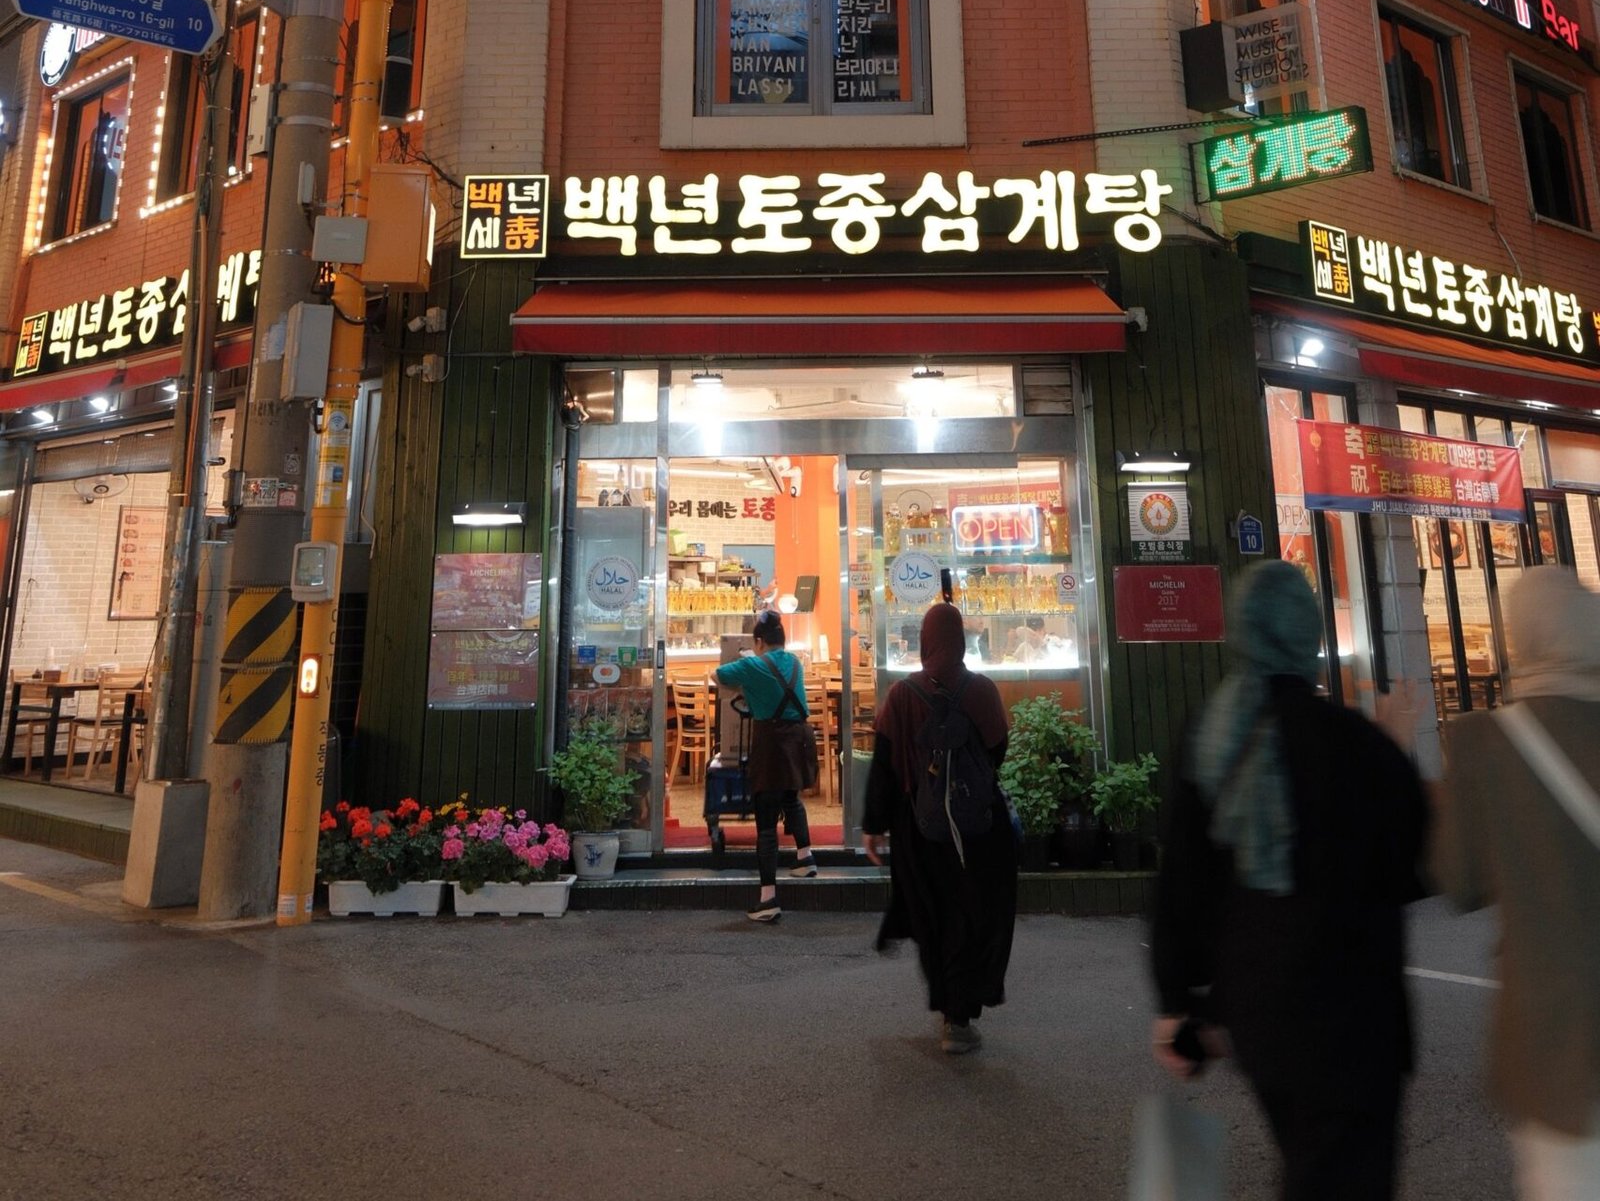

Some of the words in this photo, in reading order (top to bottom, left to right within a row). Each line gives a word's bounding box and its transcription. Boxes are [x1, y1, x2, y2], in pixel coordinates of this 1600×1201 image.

[140, 12, 175, 30] 16-gil
[187, 16, 203, 32] 10
[838, 15, 873, 34] 치킨
[1237, 18, 1281, 40] WISE
[840, 35, 858, 54] 난
[1237, 36, 1288, 62] MUSIC
[732, 55, 806, 74] BRIYANI
[835, 57, 898, 75] 브리야니
[1234, 57, 1294, 84] STUDIO
[737, 78, 794, 96] LASSI
[837, 79, 876, 98] 라씨
[1209, 112, 1357, 194] 삼계탕
[469, 181, 542, 215] 백년
[562, 168, 1174, 257] 백년토종삼계탕
[1311, 227, 1347, 264] 백년
[1357, 235, 1585, 354] 백년토종삼계탕
[1344, 426, 1366, 460] 축
[1350, 465, 1370, 494] 祝
[741, 496, 776, 522] 토종
[958, 515, 1034, 543] OPEN
[1246, 534, 1257, 549] 10
[595, 567, 630, 586] حلال
[898, 562, 933, 581] حلال
[1149, 581, 1186, 589] MICHELIN
[1157, 595, 1180, 605] 2017
